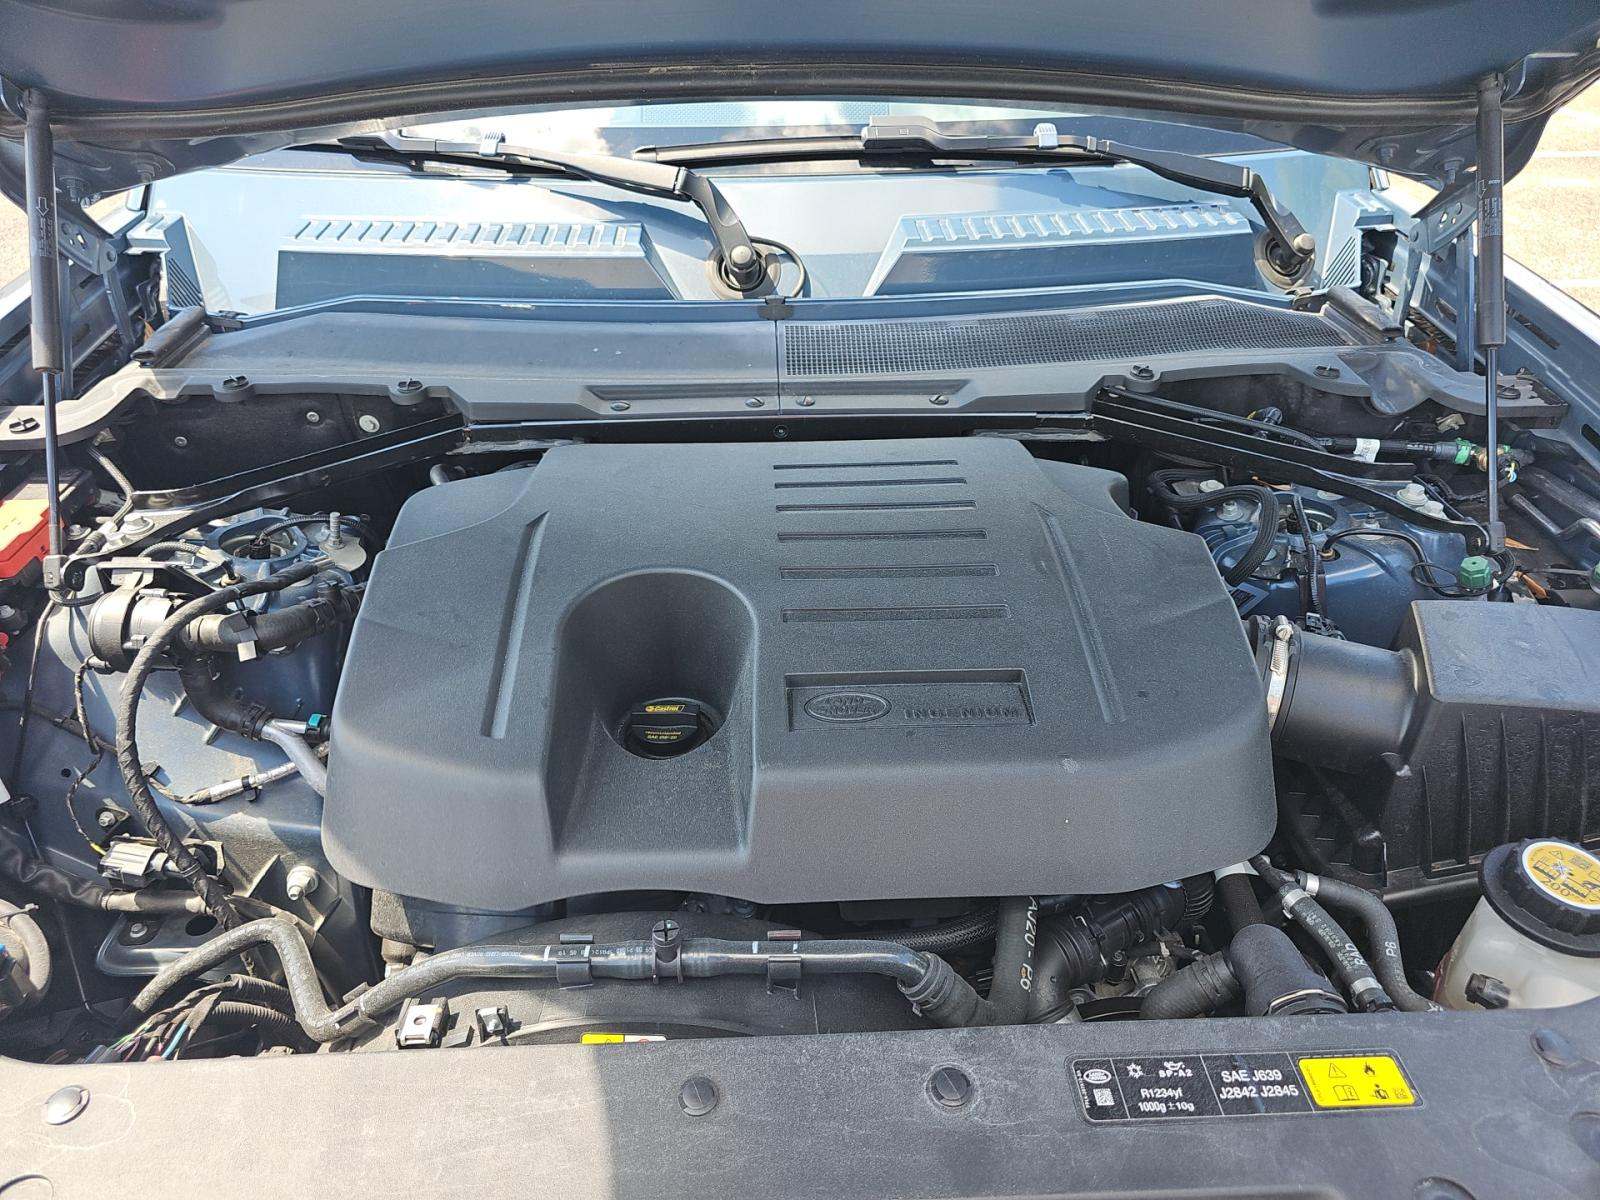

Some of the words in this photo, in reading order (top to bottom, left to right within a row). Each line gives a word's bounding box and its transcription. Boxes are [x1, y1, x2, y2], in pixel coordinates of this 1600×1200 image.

[1221, 1070, 1250, 1082] SAE
[1252, 1069, 1283, 1082] J639
[1140, 1087, 1183, 1100] R1234yf
[1219, 1086, 1259, 1099] J2842
[1260, 1084, 1299, 1098] J2845
